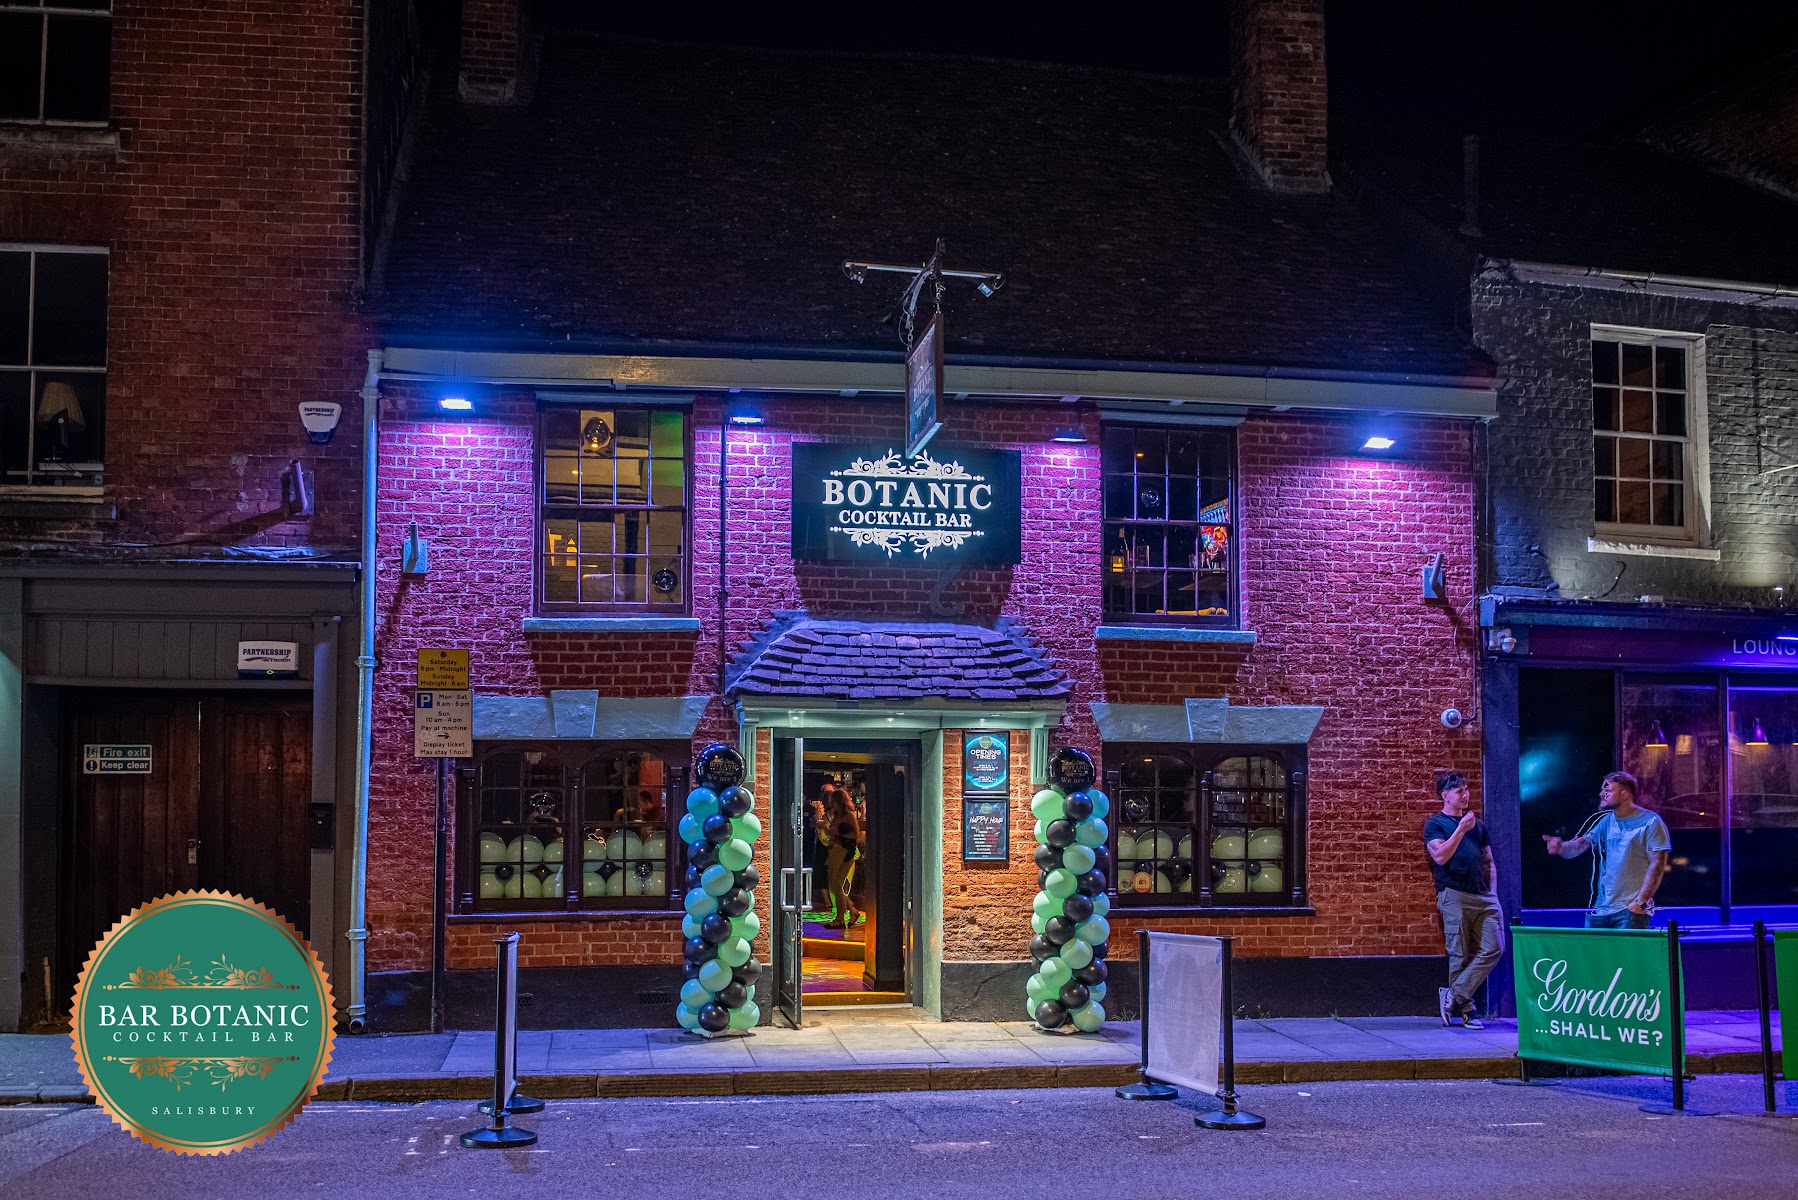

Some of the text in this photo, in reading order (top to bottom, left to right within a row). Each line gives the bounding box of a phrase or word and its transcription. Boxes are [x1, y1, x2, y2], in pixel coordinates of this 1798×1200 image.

[822, 479, 992, 510] BOTANIC
[838, 509, 972, 528] COCKTAIL BAR
[420, 694, 430, 707] P
[103, 748, 147, 756] Fire exit
[101, 761, 123, 770] Keep
[710, 762, 739, 771] BOTANIC
[1532, 958, 1662, 1022] Gordon's
[1618, 1026, 1663, 1046] WE?
